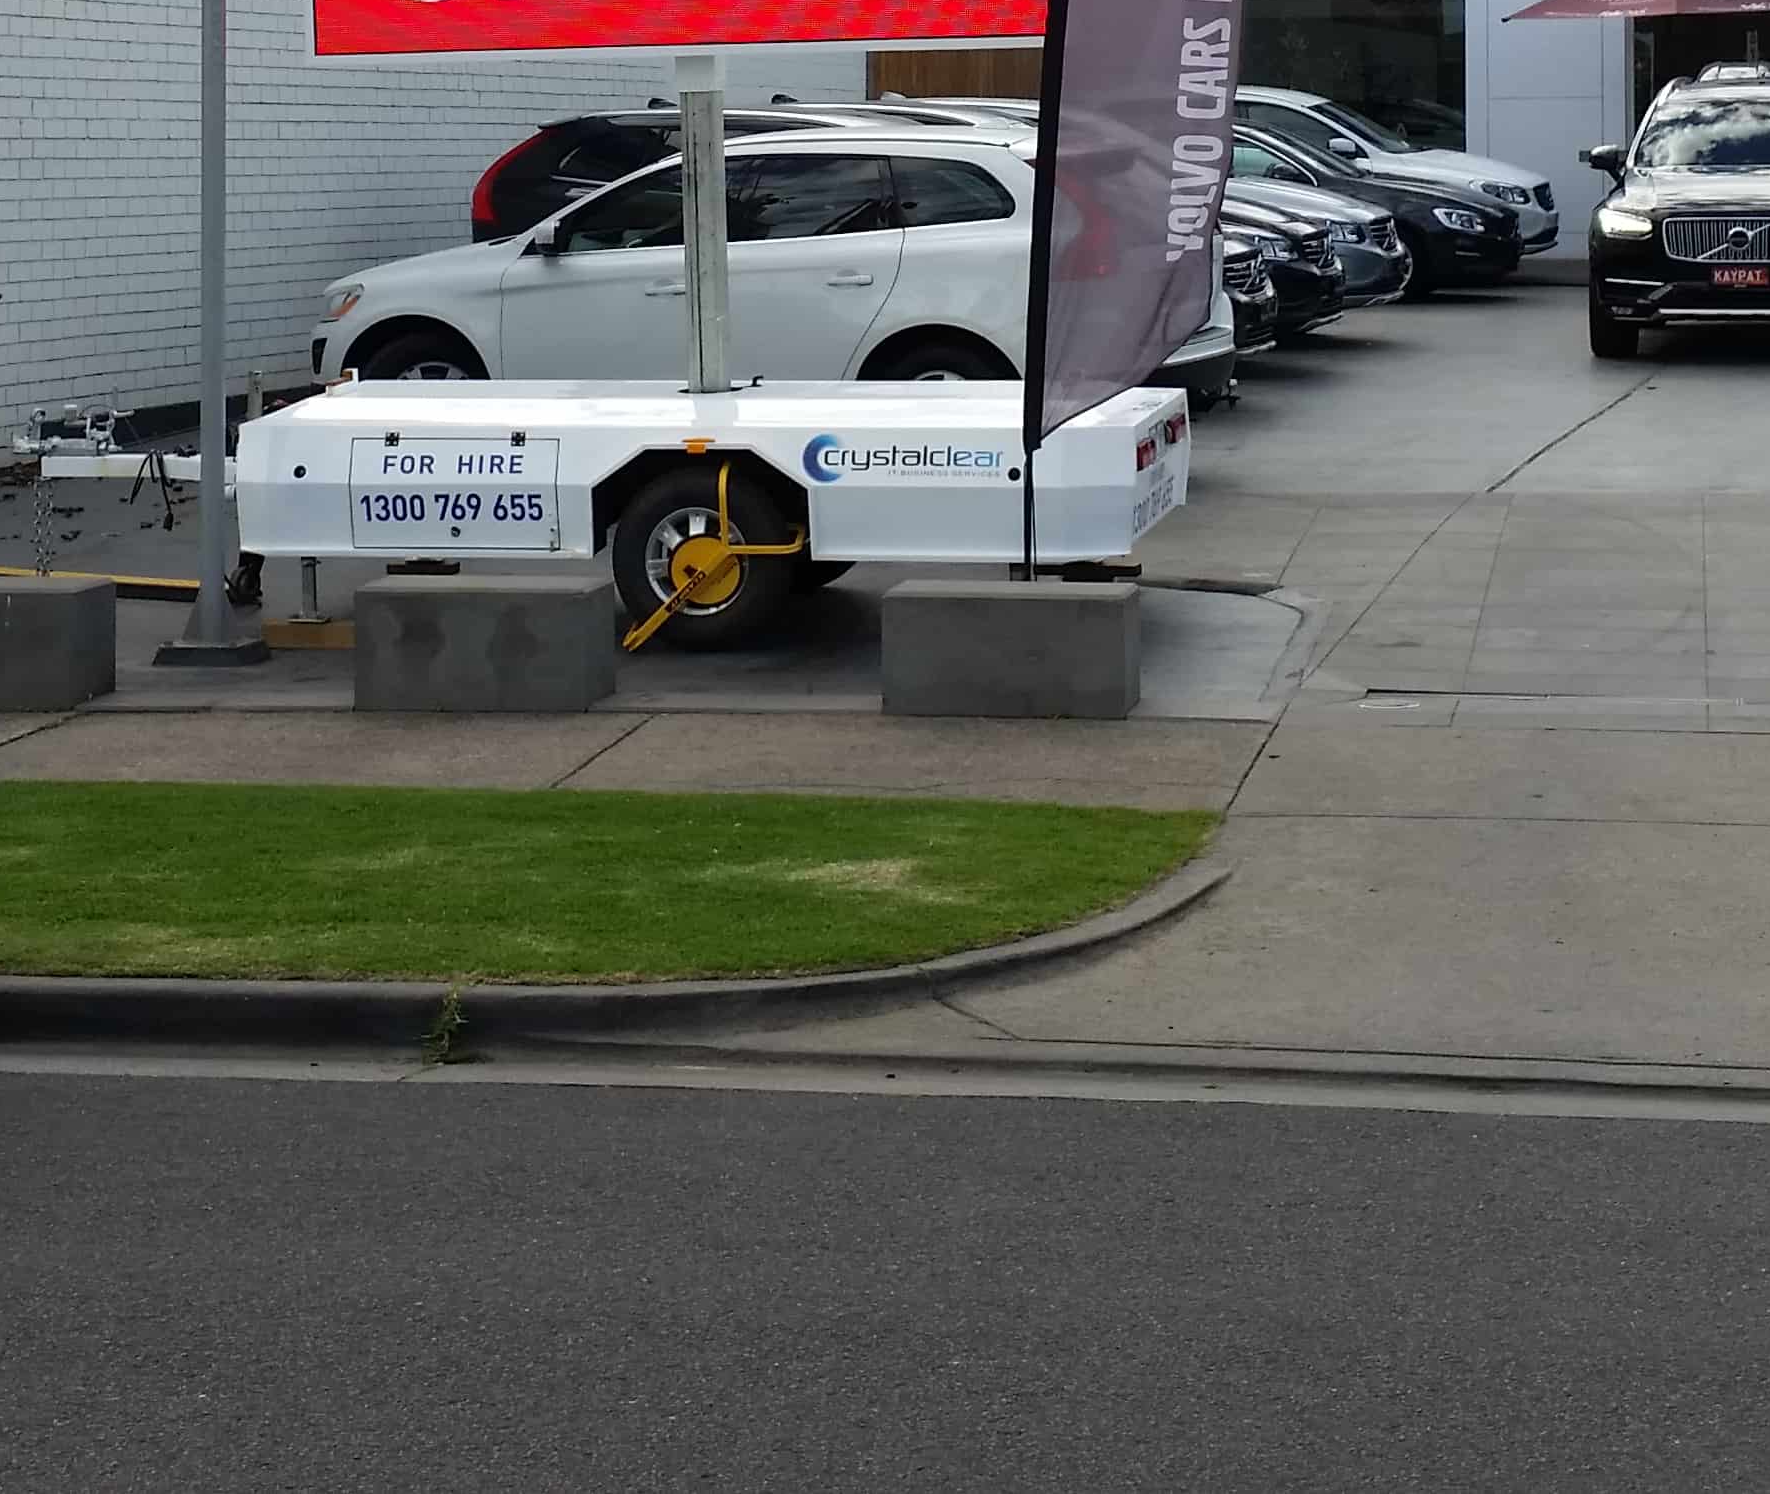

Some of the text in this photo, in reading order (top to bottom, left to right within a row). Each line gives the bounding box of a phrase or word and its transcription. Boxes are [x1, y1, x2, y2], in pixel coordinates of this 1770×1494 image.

[1176, 17, 1231, 121] CARS
[1165, 135, 1224, 263] VOLVO
[382, 454, 525, 475] FOR HIRE
[822, 444, 1005, 471] crystalclear
[359, 493, 544, 522] 1300 769 655
